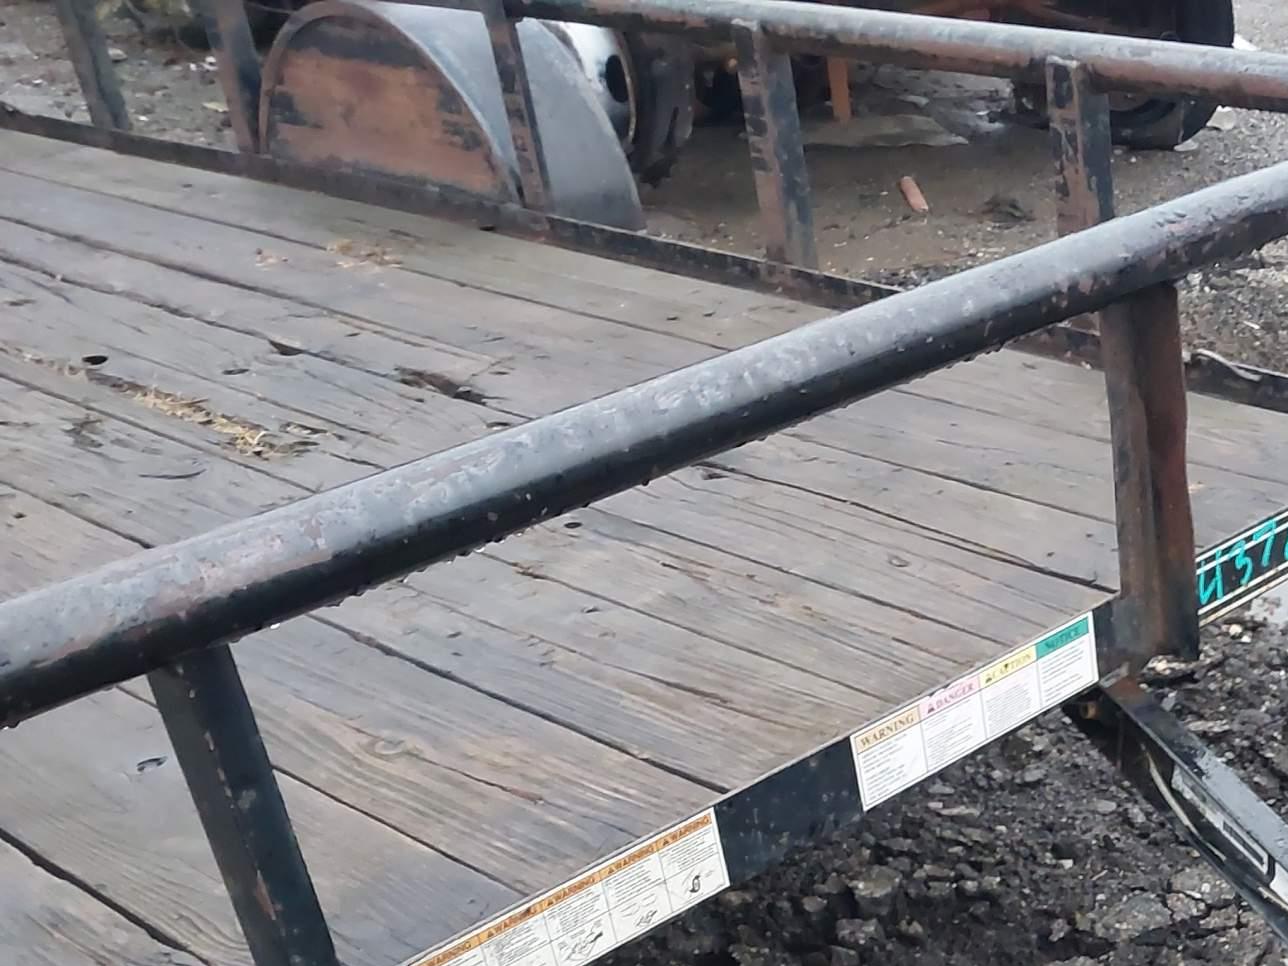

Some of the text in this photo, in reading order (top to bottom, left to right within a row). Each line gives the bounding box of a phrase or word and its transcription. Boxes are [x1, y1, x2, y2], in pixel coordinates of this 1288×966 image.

[1043, 625, 1082, 651] NOTICE
[936, 682, 976, 710] DANGER
[860, 713, 915, 747] WARNING
[671, 814, 711, 840] WARNING
[614, 845, 656, 870] WARNING
[553, 876, 597, 901] WARNING
